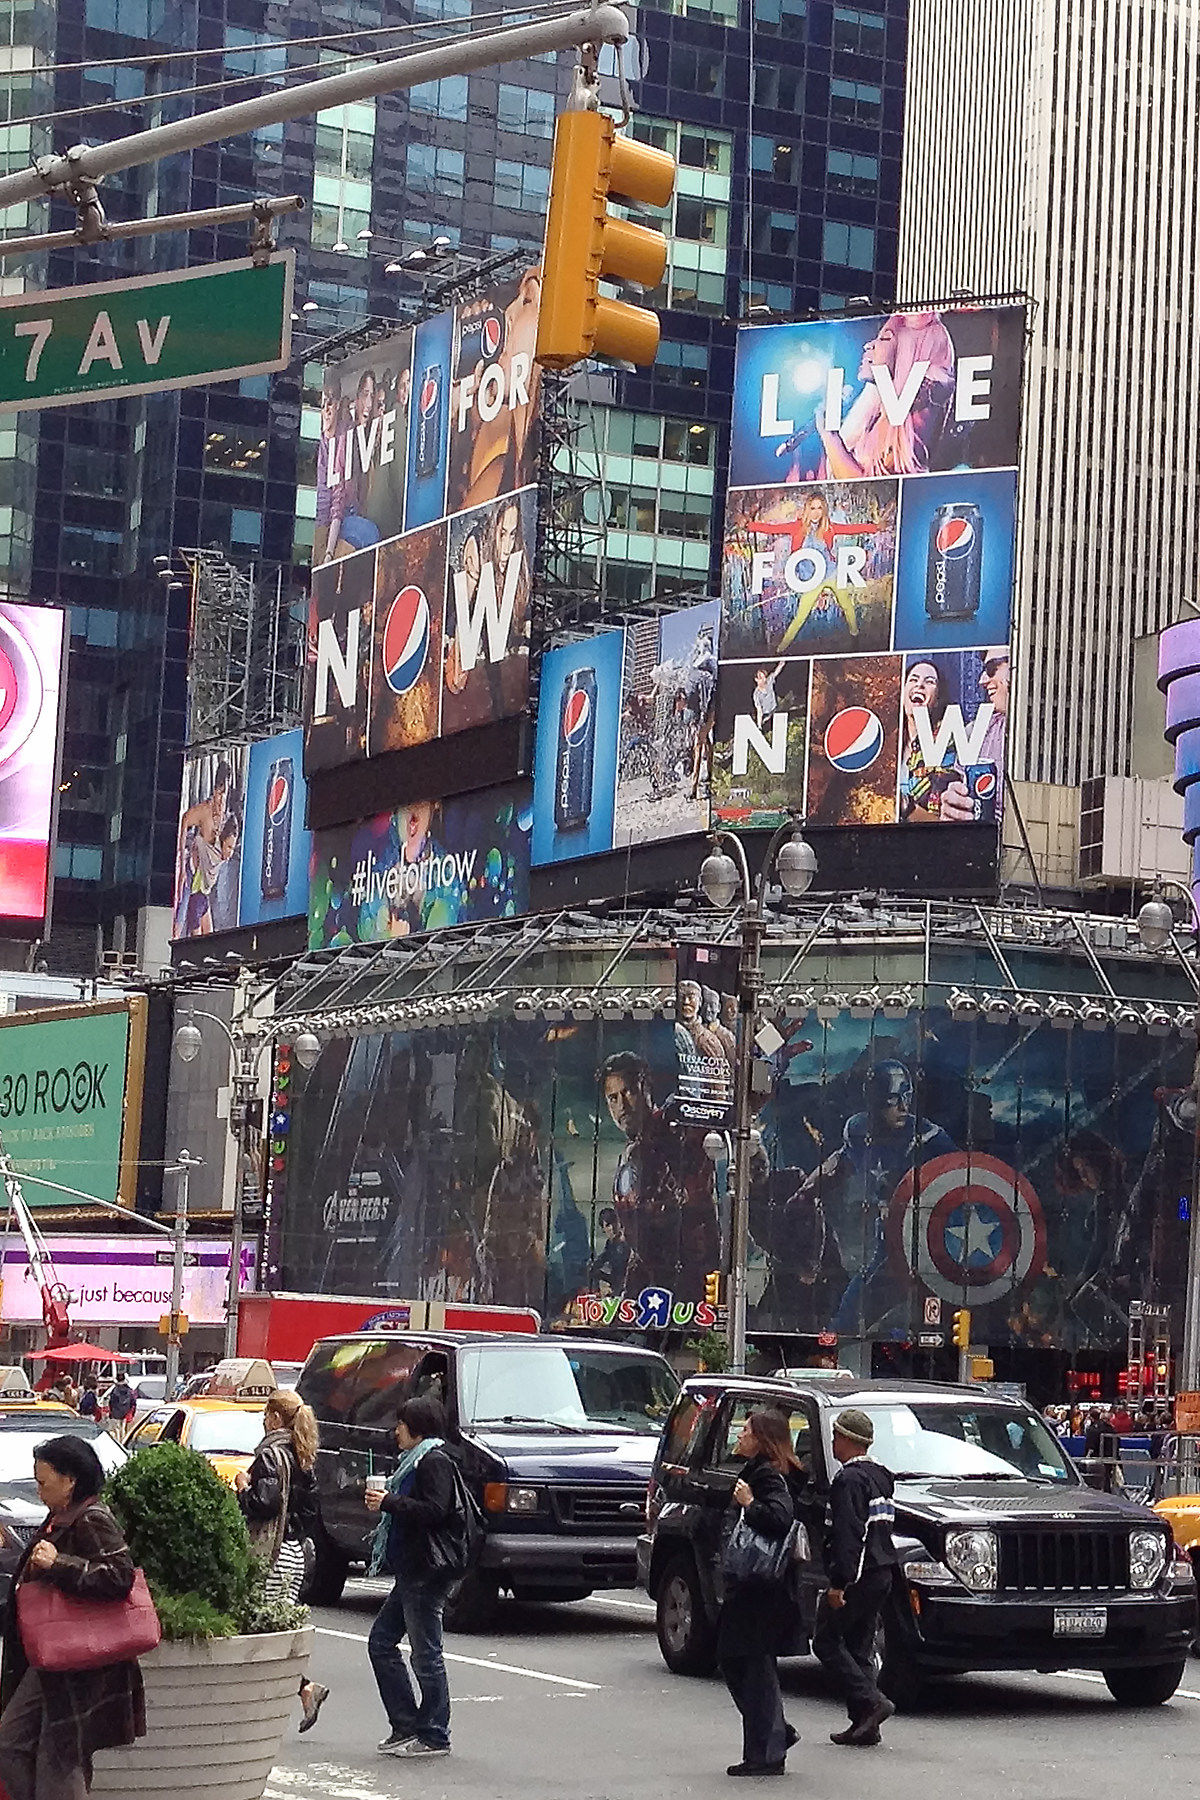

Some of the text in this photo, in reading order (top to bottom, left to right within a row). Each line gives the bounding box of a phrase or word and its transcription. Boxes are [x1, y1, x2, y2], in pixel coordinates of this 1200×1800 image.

[14, 311, 171, 382] 7 Av
[456, 352, 534, 433] FOR
[760, 354, 993, 438] LIVE
[324, 410, 397, 488] LIVE
[751, 546, 866, 595] FOR
[352, 849, 477, 907] #livefornow
[79, 1287, 108, 1307] just
